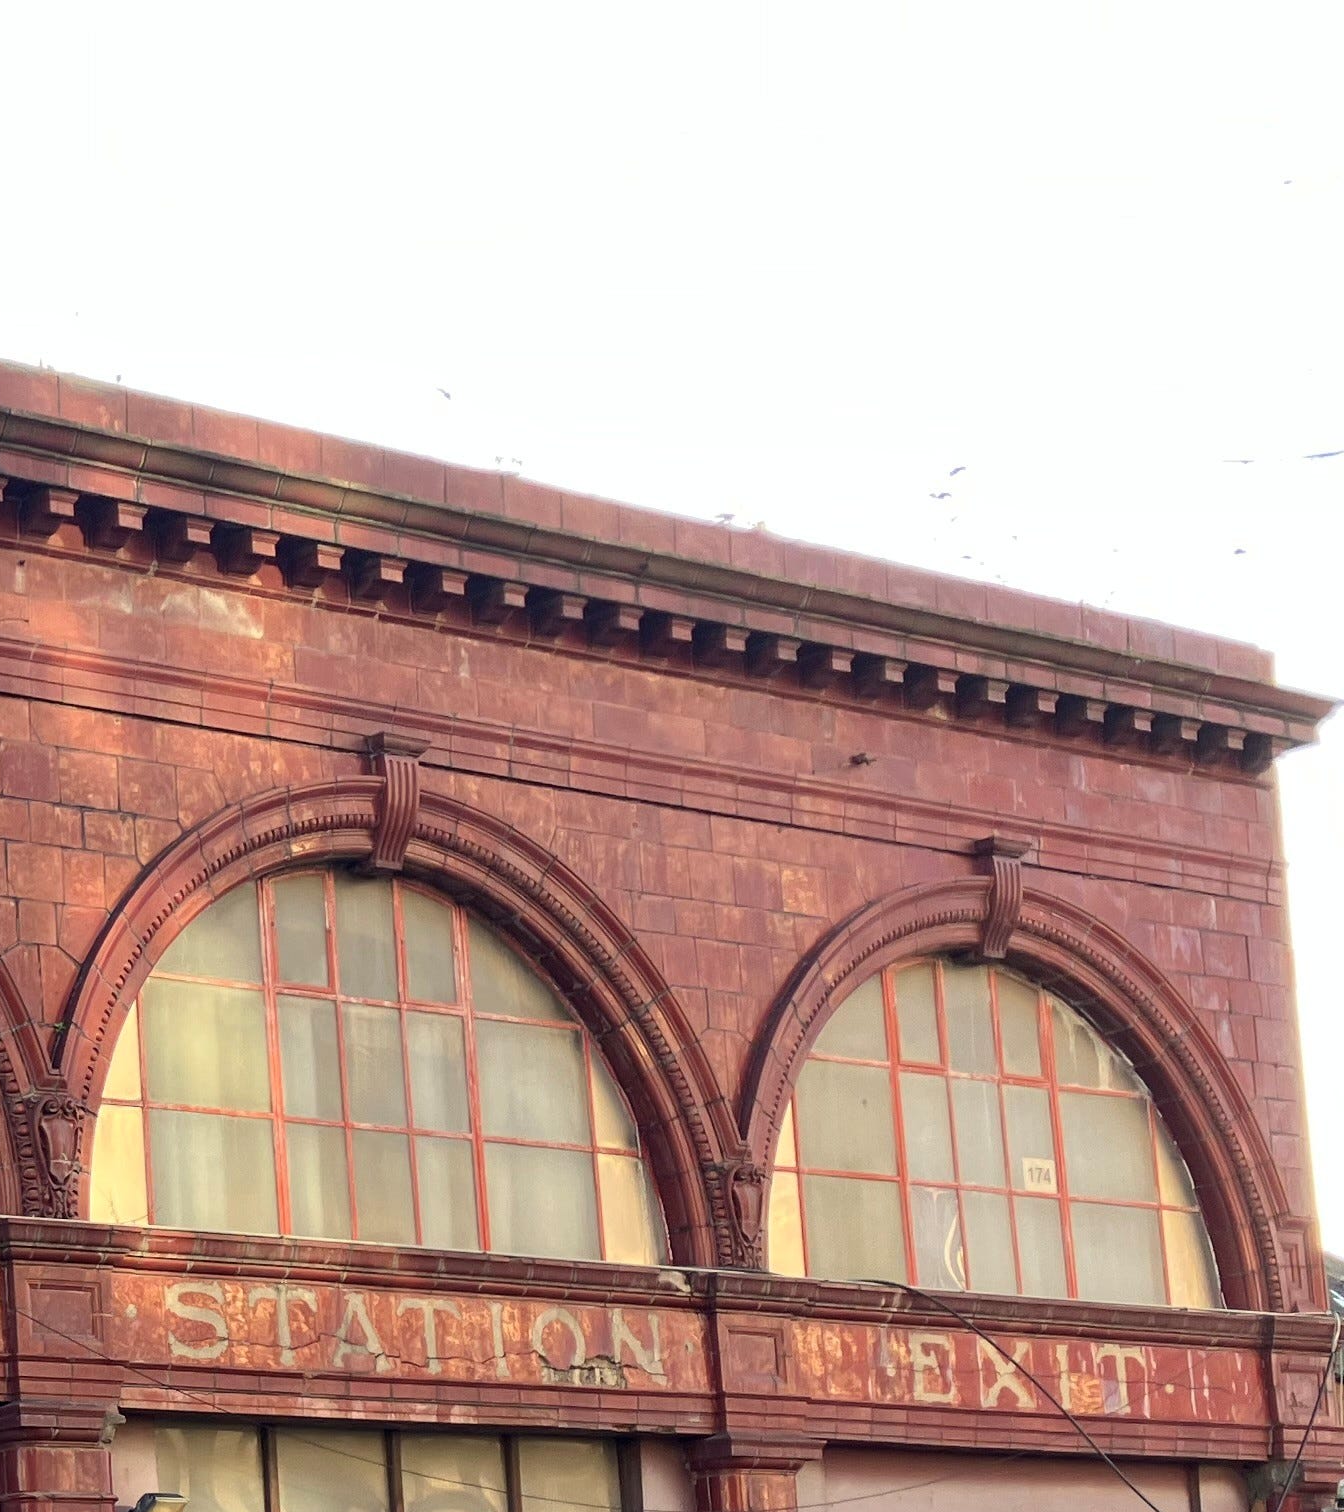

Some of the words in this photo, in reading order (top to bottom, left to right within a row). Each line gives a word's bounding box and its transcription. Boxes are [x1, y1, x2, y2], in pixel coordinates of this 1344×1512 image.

[1028, 1167, 1052, 1184] 174
[164, 1280, 668, 1385] STATION
[909, 1333, 1148, 1416] EXIT
